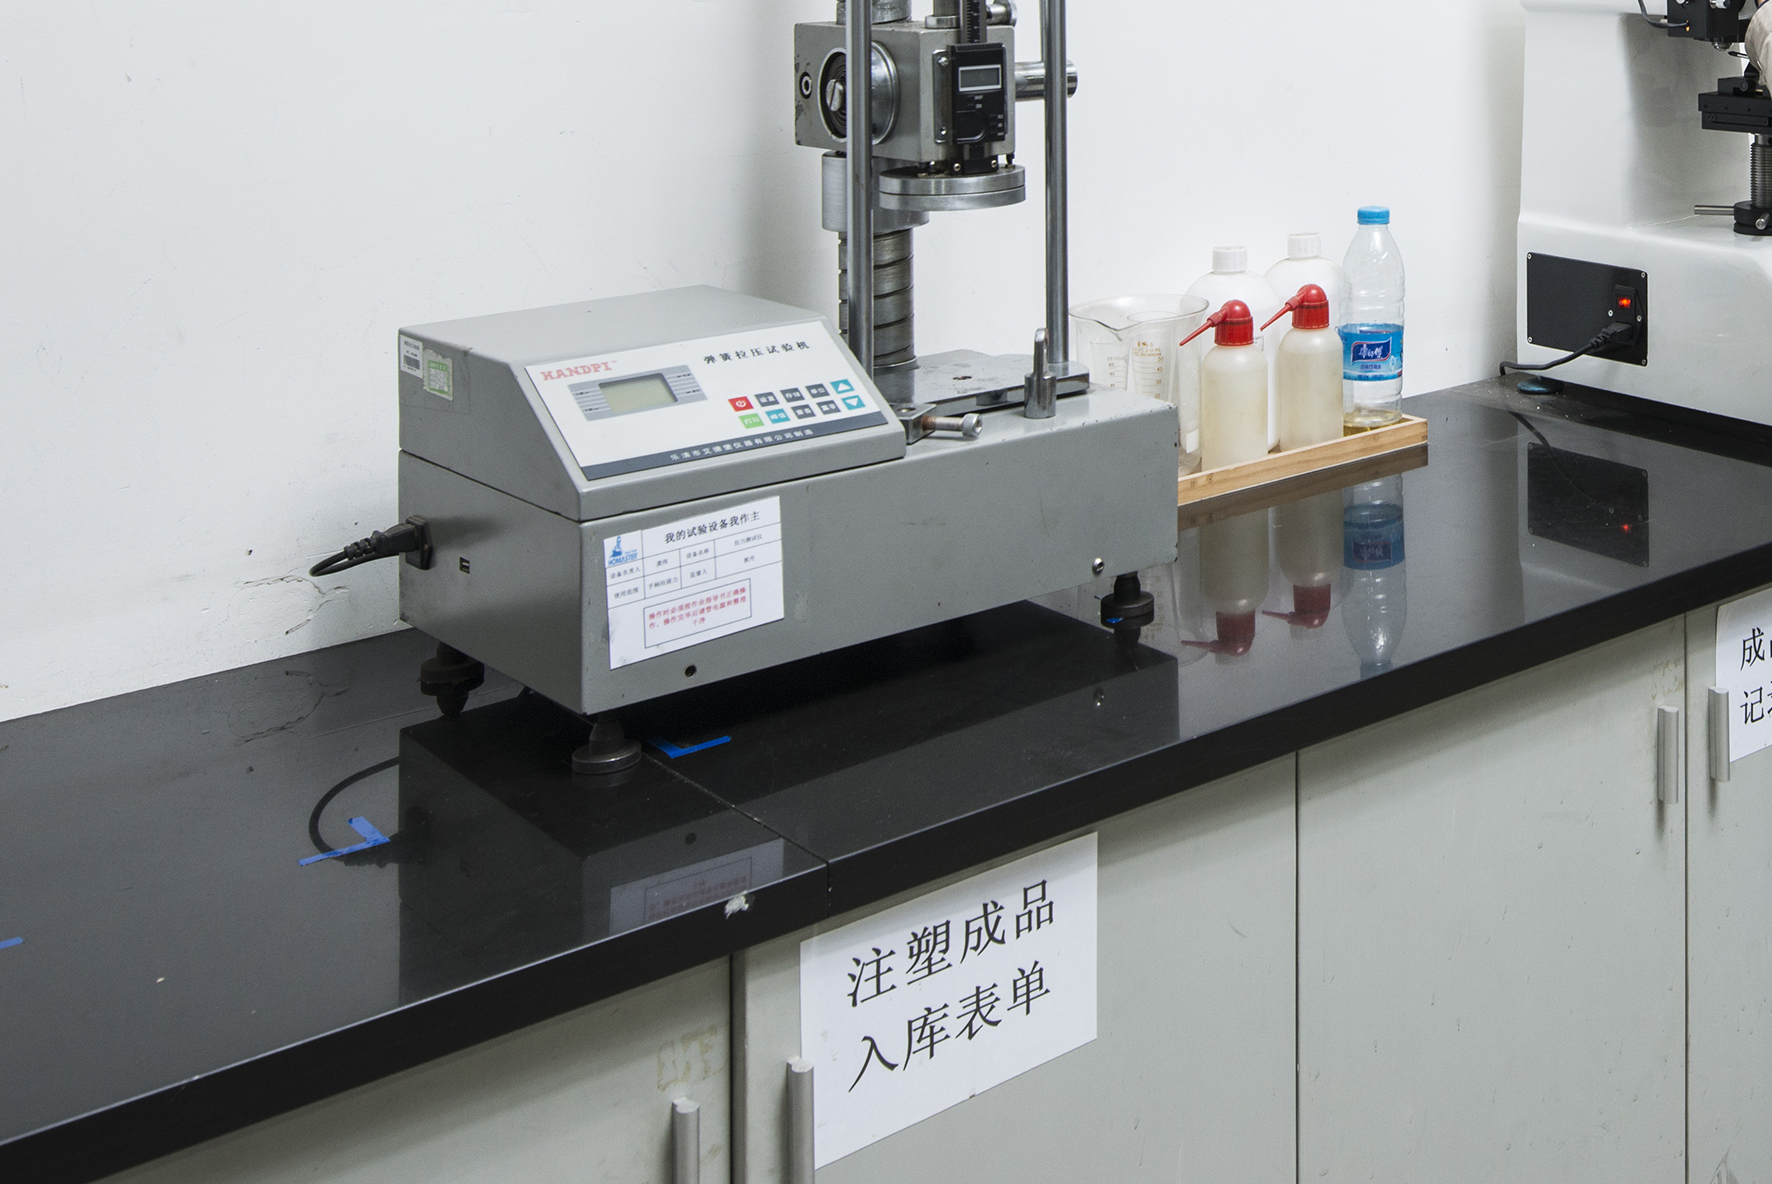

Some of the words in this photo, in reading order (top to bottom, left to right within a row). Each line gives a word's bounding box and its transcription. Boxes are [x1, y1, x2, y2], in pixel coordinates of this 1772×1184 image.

[703, 341, 810, 364] 弹簧拉压试验机
[540, 361, 612, 381] HANDPI
[664, 511, 760, 544] 我的试验设备我作主
[847, 879, 1054, 1007] 注塑成品
[848, 960, 1051, 1093] 入库表单
